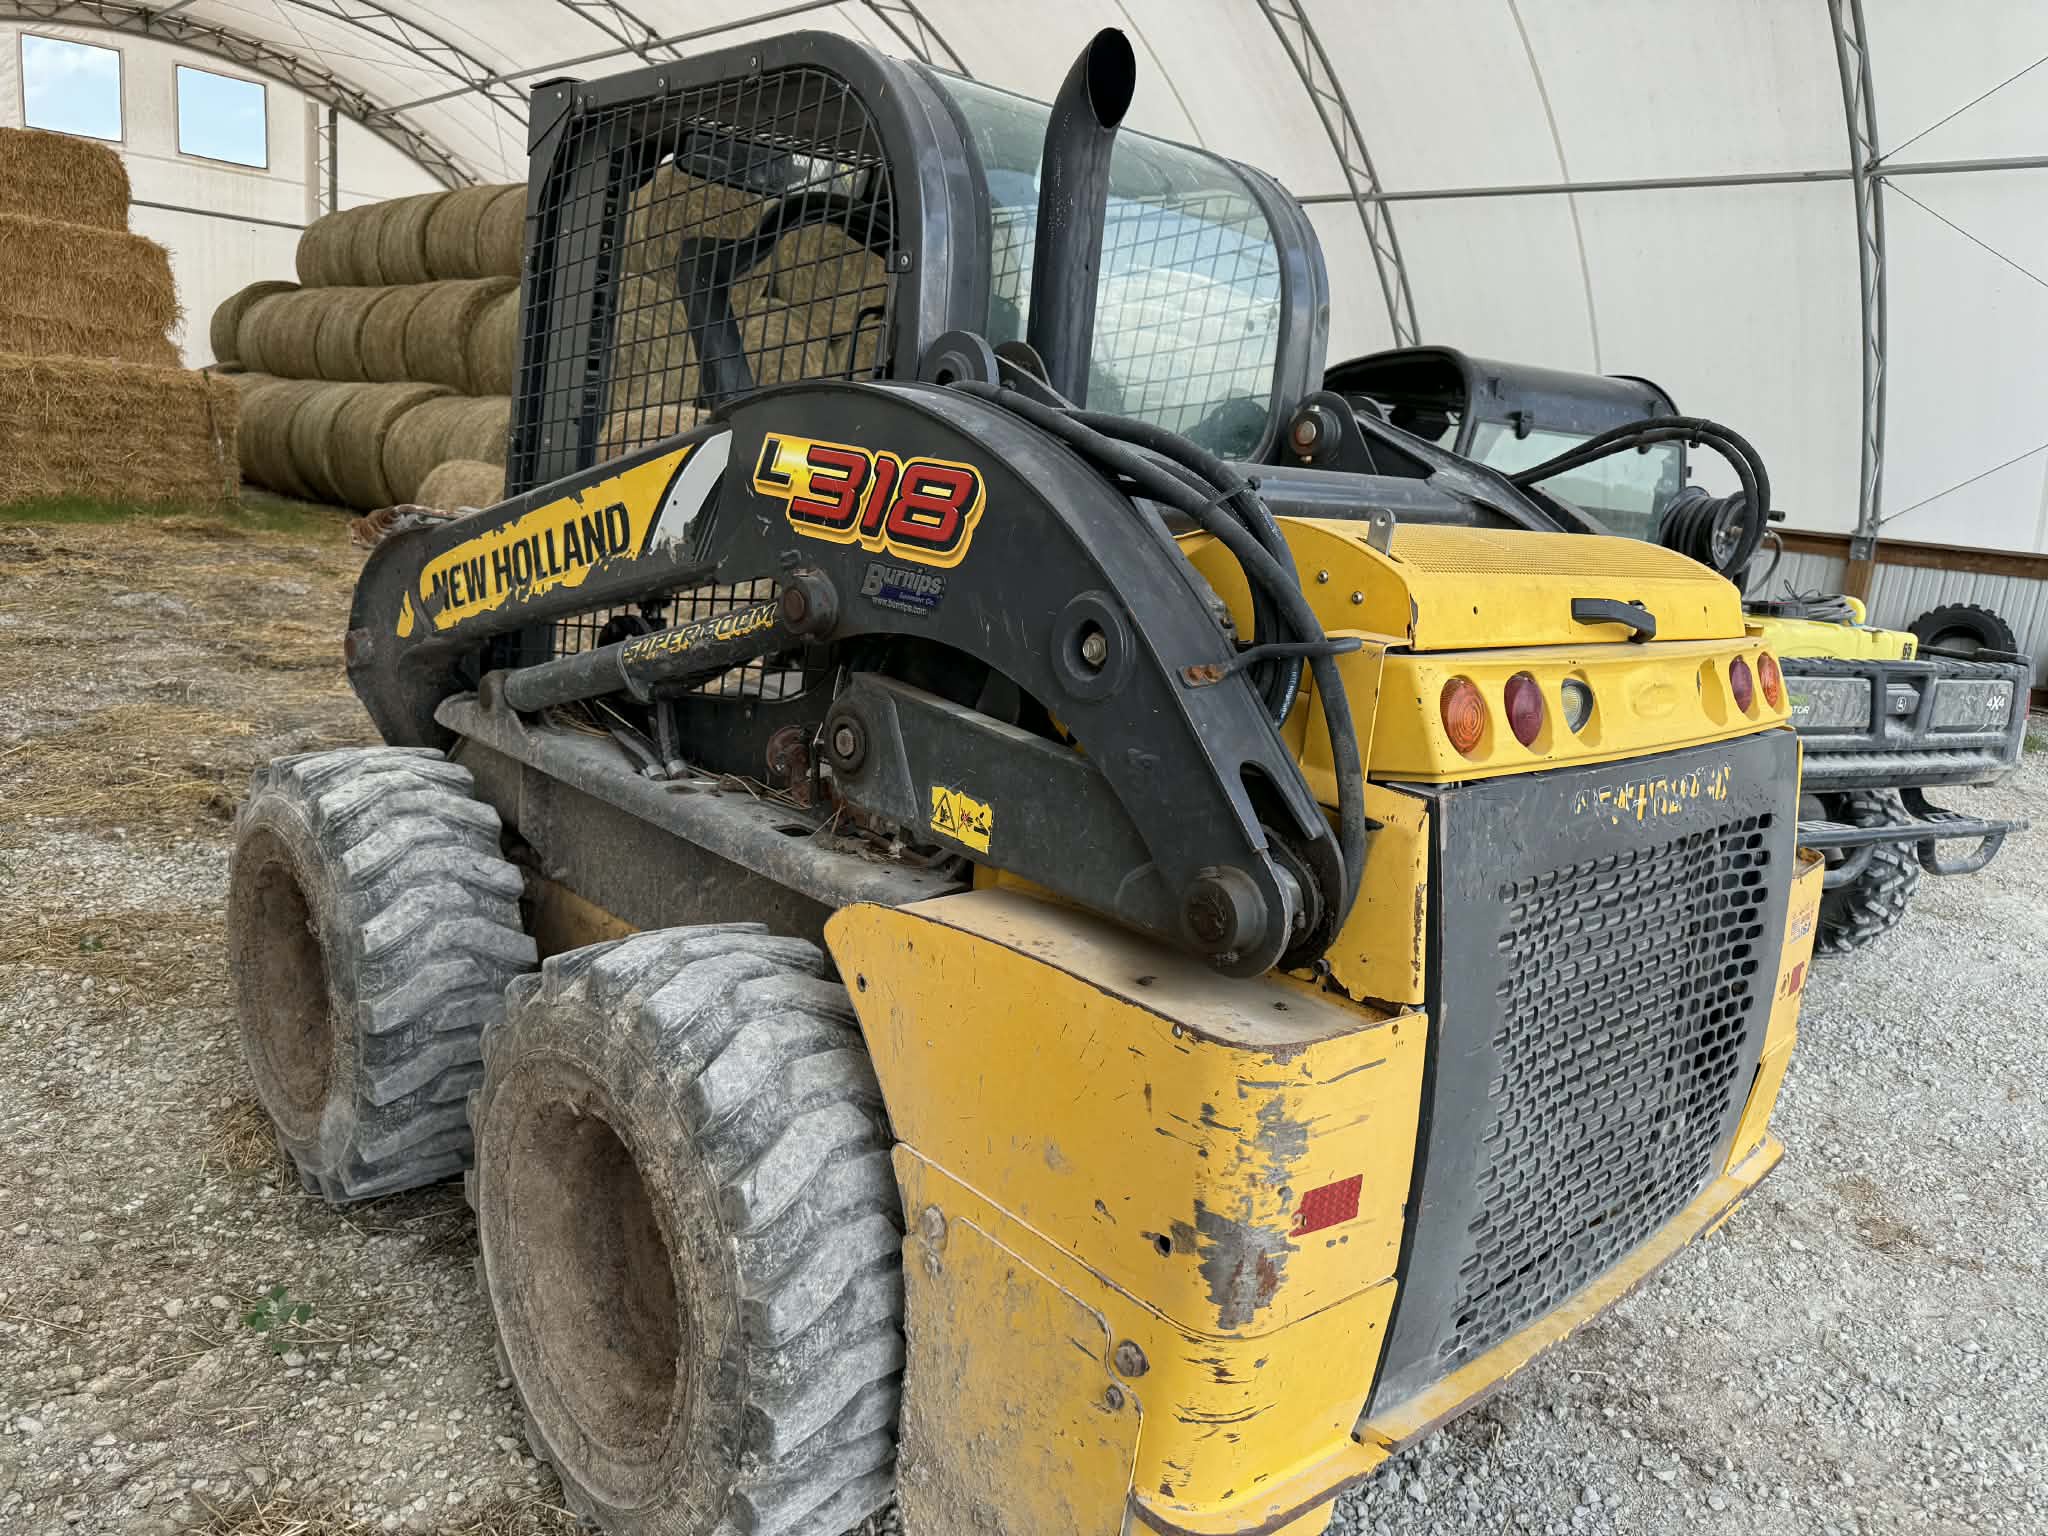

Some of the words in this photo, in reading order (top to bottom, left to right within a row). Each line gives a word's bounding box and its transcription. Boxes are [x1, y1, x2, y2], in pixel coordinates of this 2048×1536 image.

[756, 437, 976, 556] L318
[430, 554, 488, 612] NEW
[491, 501, 631, 594] HOLLAND
[861, 563, 943, 596] Burnips
